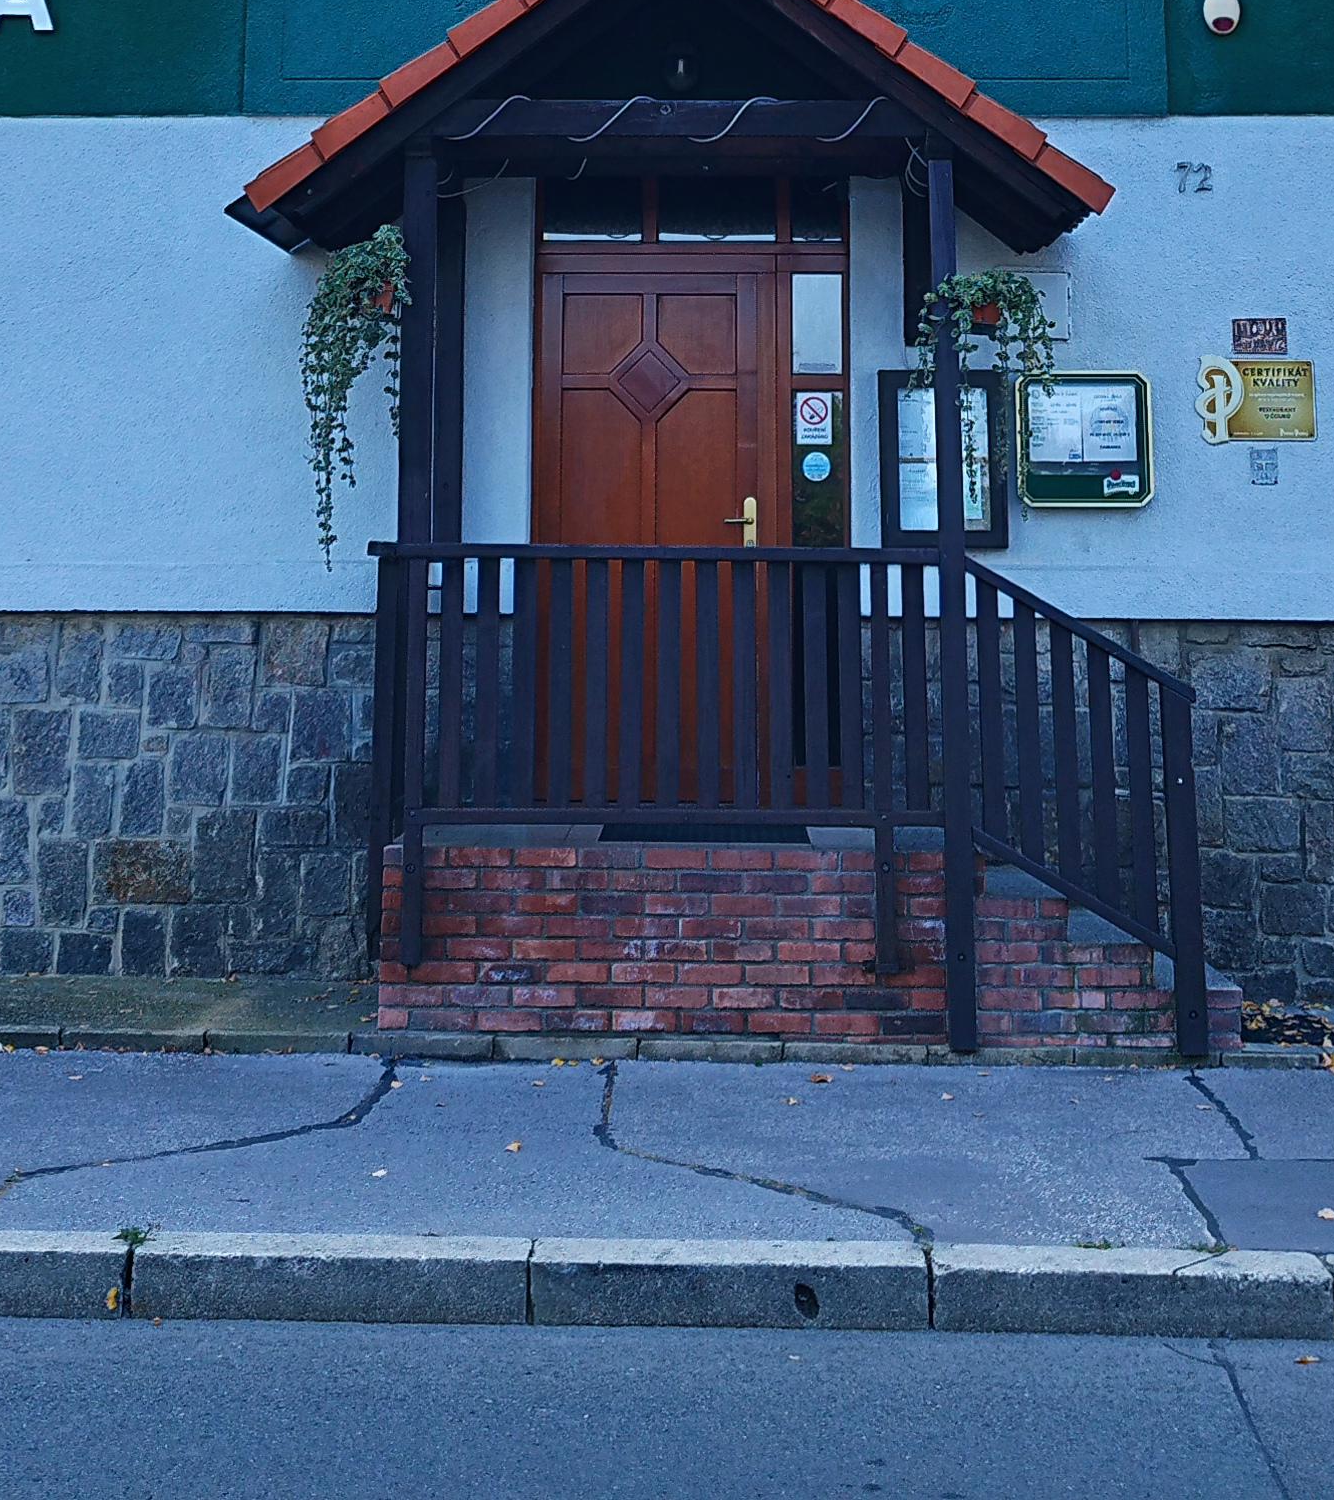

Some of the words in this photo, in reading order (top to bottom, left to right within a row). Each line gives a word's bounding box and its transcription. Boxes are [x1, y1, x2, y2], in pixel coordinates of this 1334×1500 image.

[1176, 161, 1213, 193] 72
[1242, 366, 1308, 377] CERTIFIKÁT
[1253, 378, 1299, 387] KVALITY
